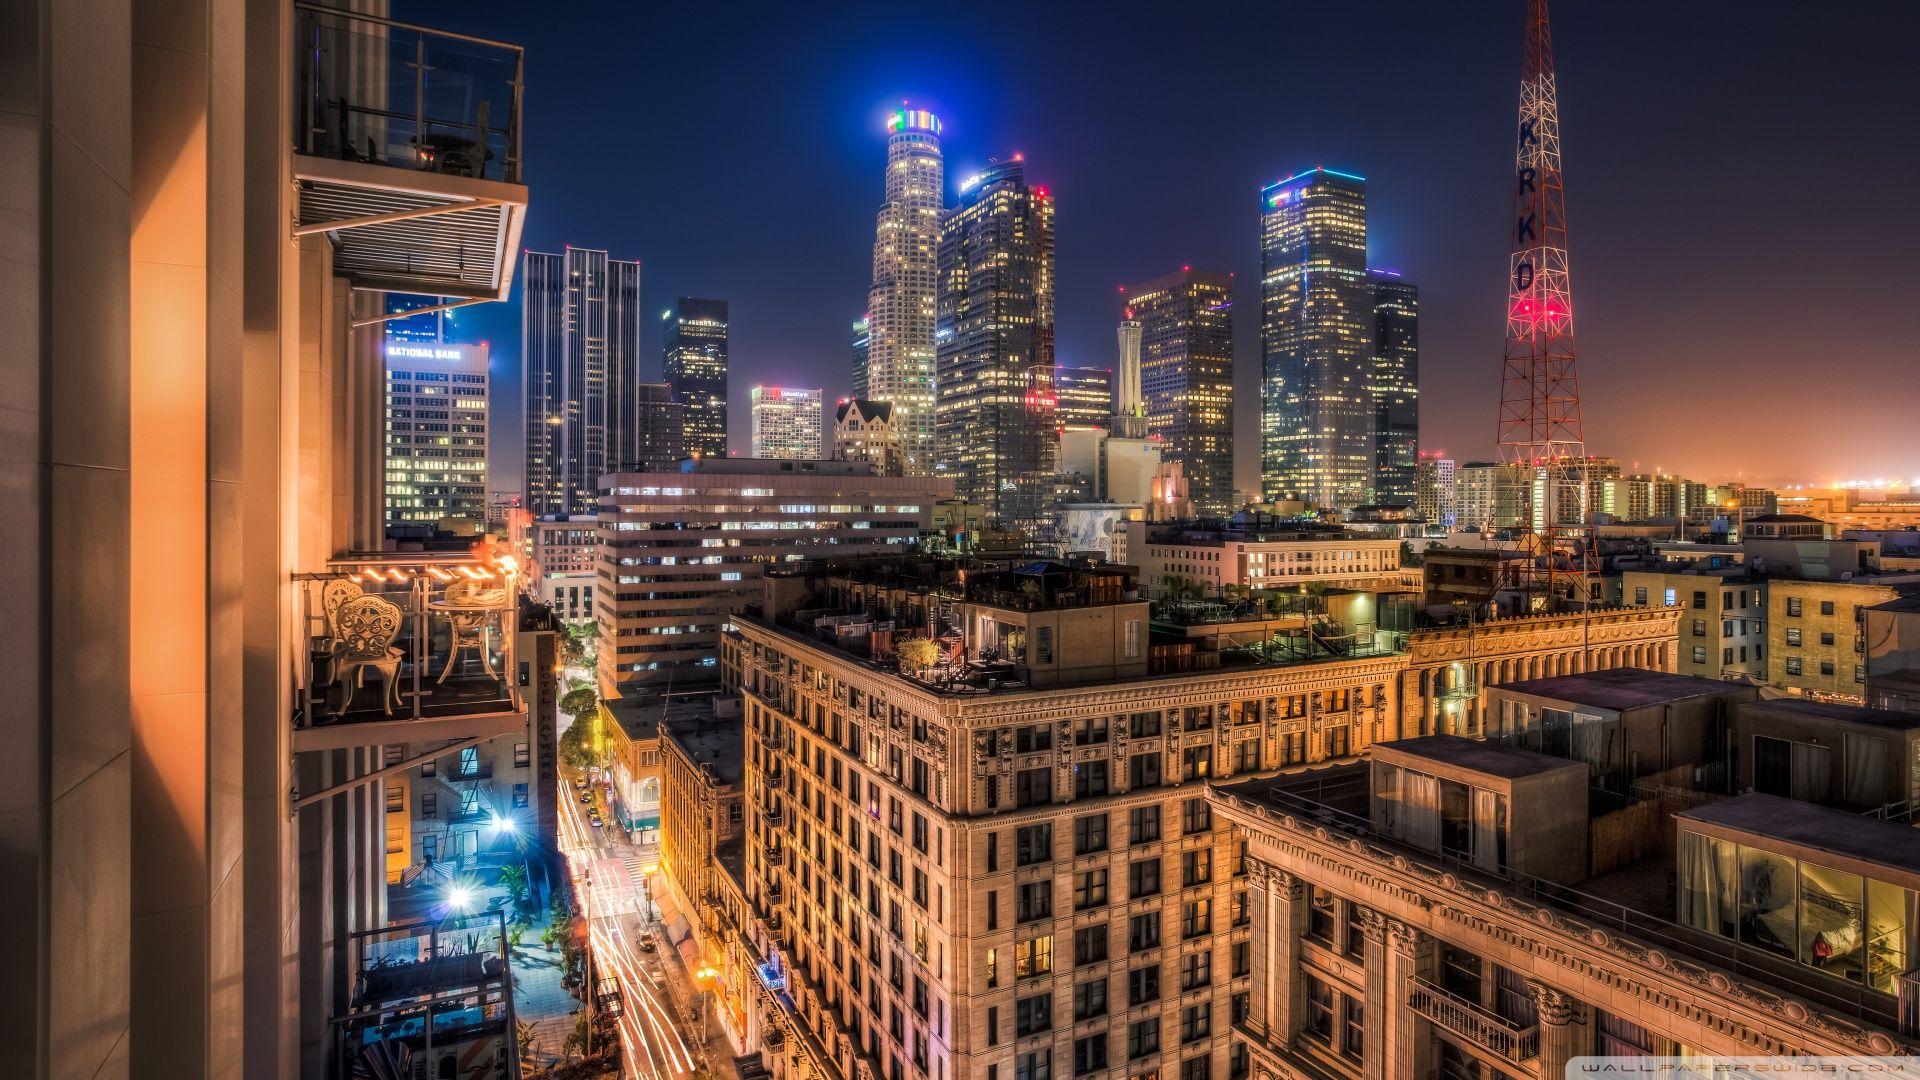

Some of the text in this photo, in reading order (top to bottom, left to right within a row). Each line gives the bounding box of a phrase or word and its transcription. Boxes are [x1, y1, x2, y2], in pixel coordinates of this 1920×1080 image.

[1517, 117, 1538, 291] KRKD
[388, 347, 460, 360] NATIONAL BANK
